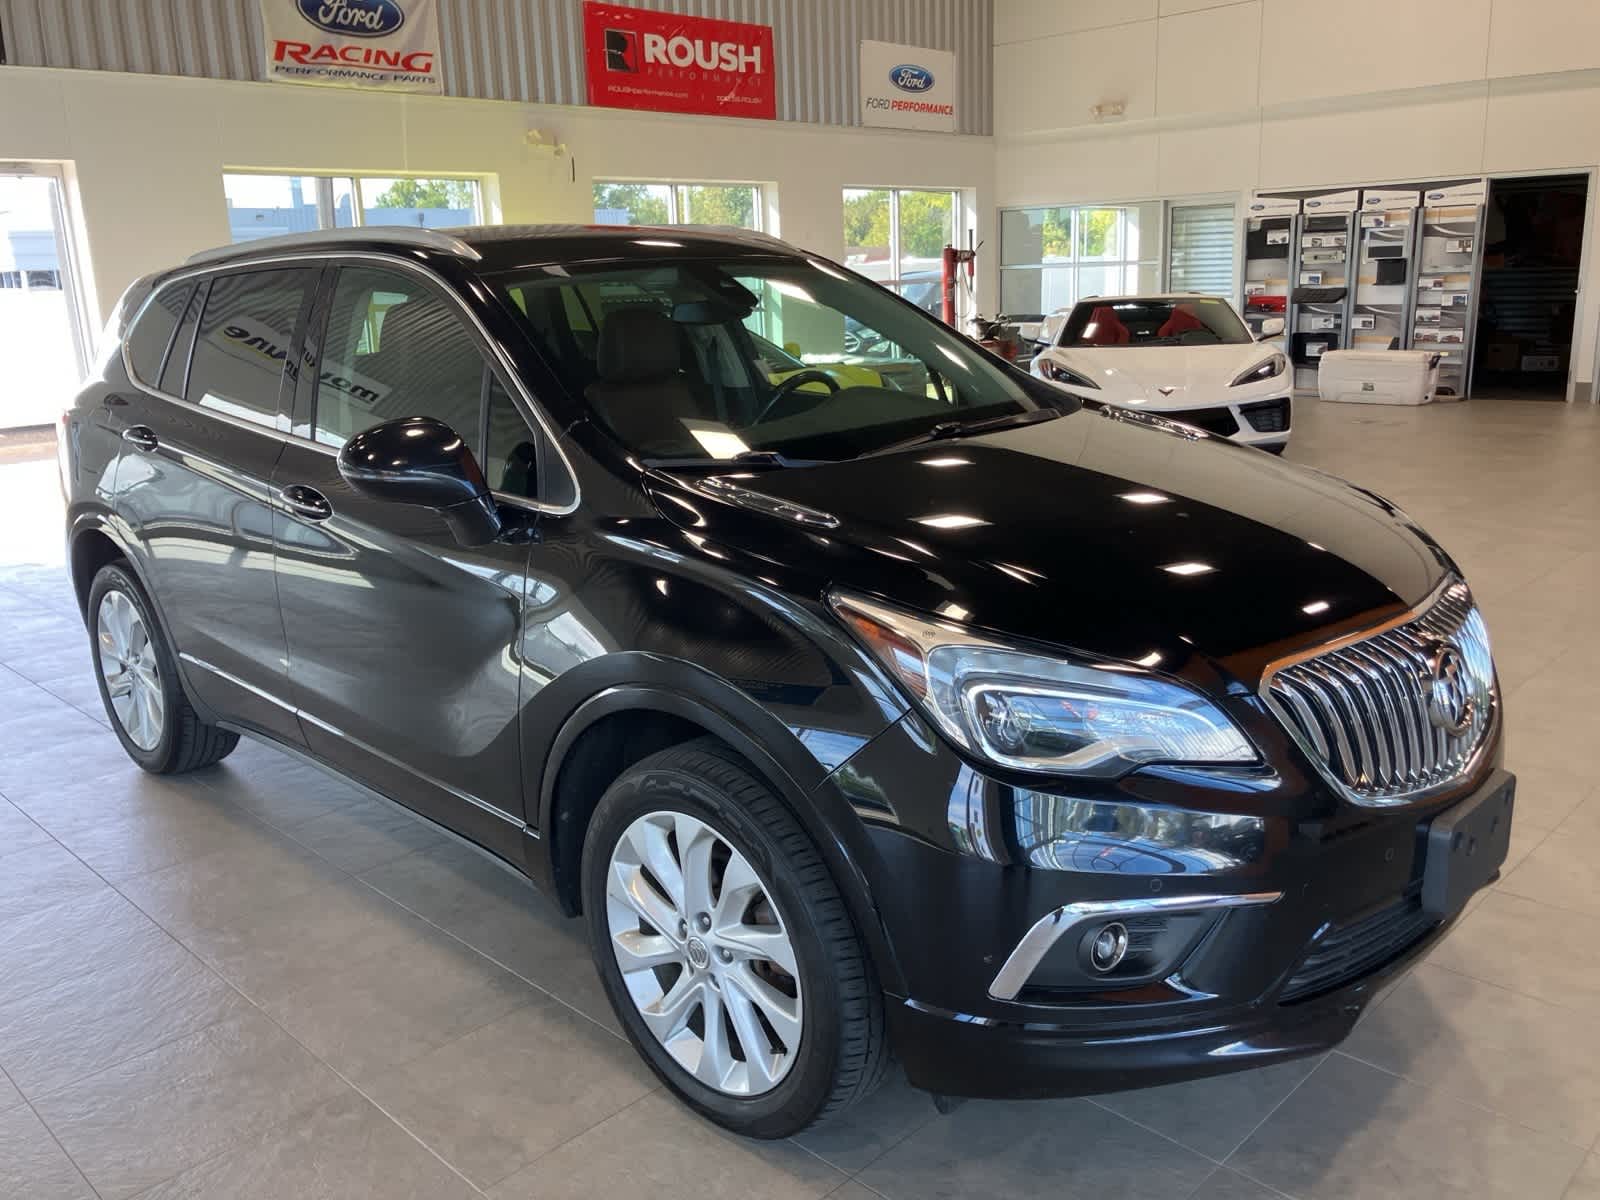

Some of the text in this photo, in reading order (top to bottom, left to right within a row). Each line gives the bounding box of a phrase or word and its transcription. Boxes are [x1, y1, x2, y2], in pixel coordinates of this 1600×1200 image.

[318, 0, 384, 30] Ford
[273, 39, 433, 73] RACING
[643, 33, 762, 73] ROUSH
[274, 65, 436, 84] PERFORMANCE PARTS
[898, 68, 926, 89] Ford
[866, 97, 953, 116] FORD PERFORMANCE
